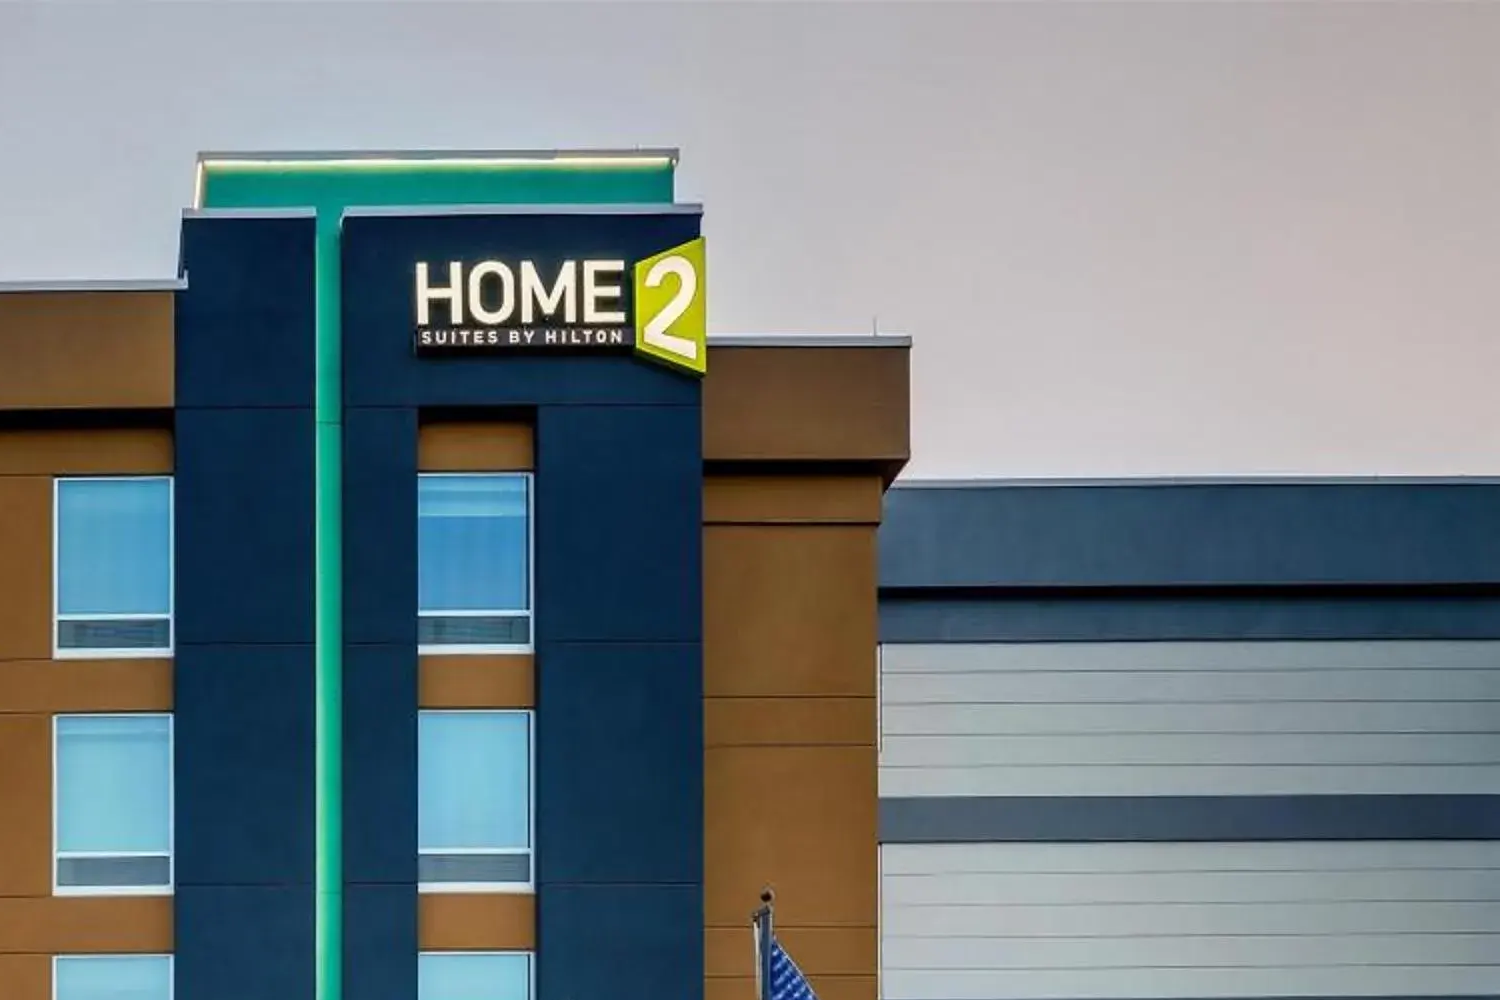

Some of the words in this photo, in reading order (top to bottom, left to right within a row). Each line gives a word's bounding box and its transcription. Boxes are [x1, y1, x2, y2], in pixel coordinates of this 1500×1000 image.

[415, 259, 626, 325] HOME
[642, 254, 698, 361] 2
[421, 329, 499, 345] SUITES
[509, 329, 535, 344] BY
[545, 329, 623, 344] HILTON
